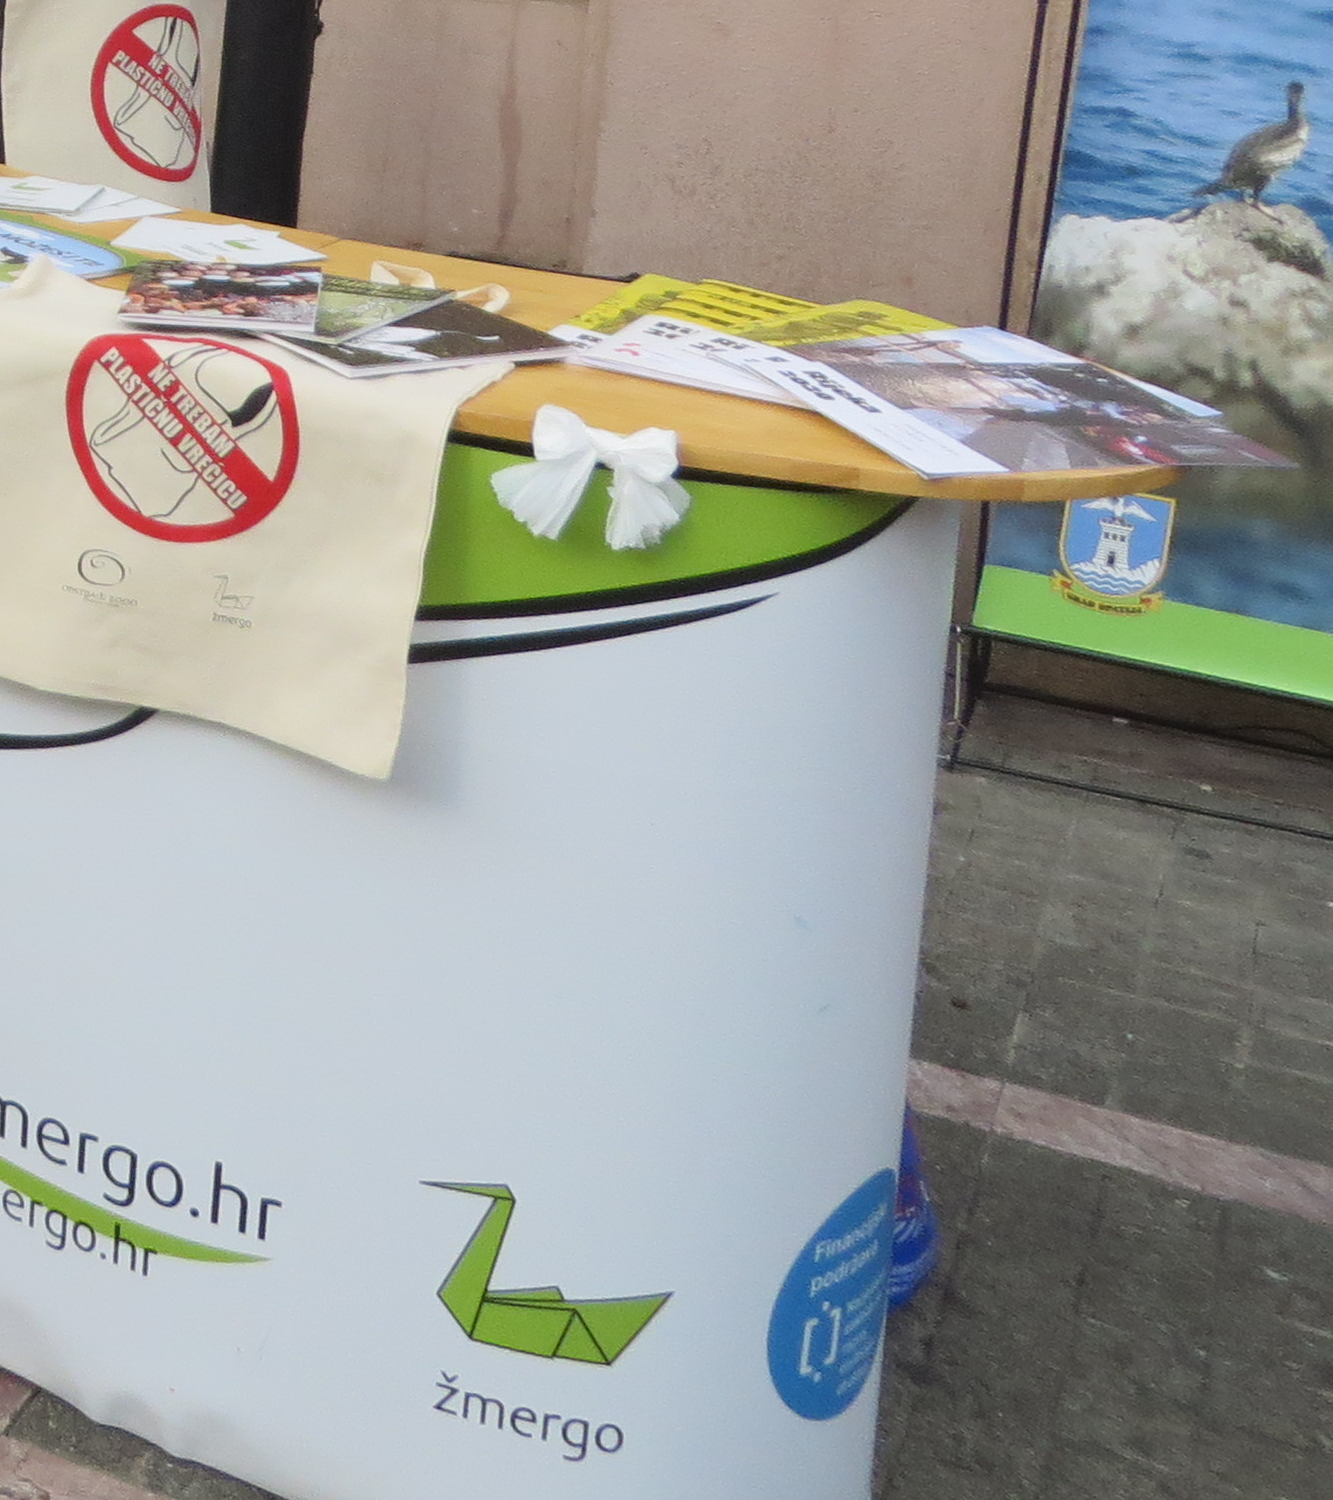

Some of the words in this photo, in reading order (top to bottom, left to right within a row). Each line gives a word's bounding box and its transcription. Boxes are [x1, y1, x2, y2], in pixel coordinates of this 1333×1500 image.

[148, 53, 164, 75] NE
[99, 346, 184, 444] PLASTIČNU
[177, 432, 249, 511] VREĆICU
[147, 363, 174, 392] NE
[171, 384, 236, 459] TREBAM
[432, 1369, 625, 1462] žmergo
